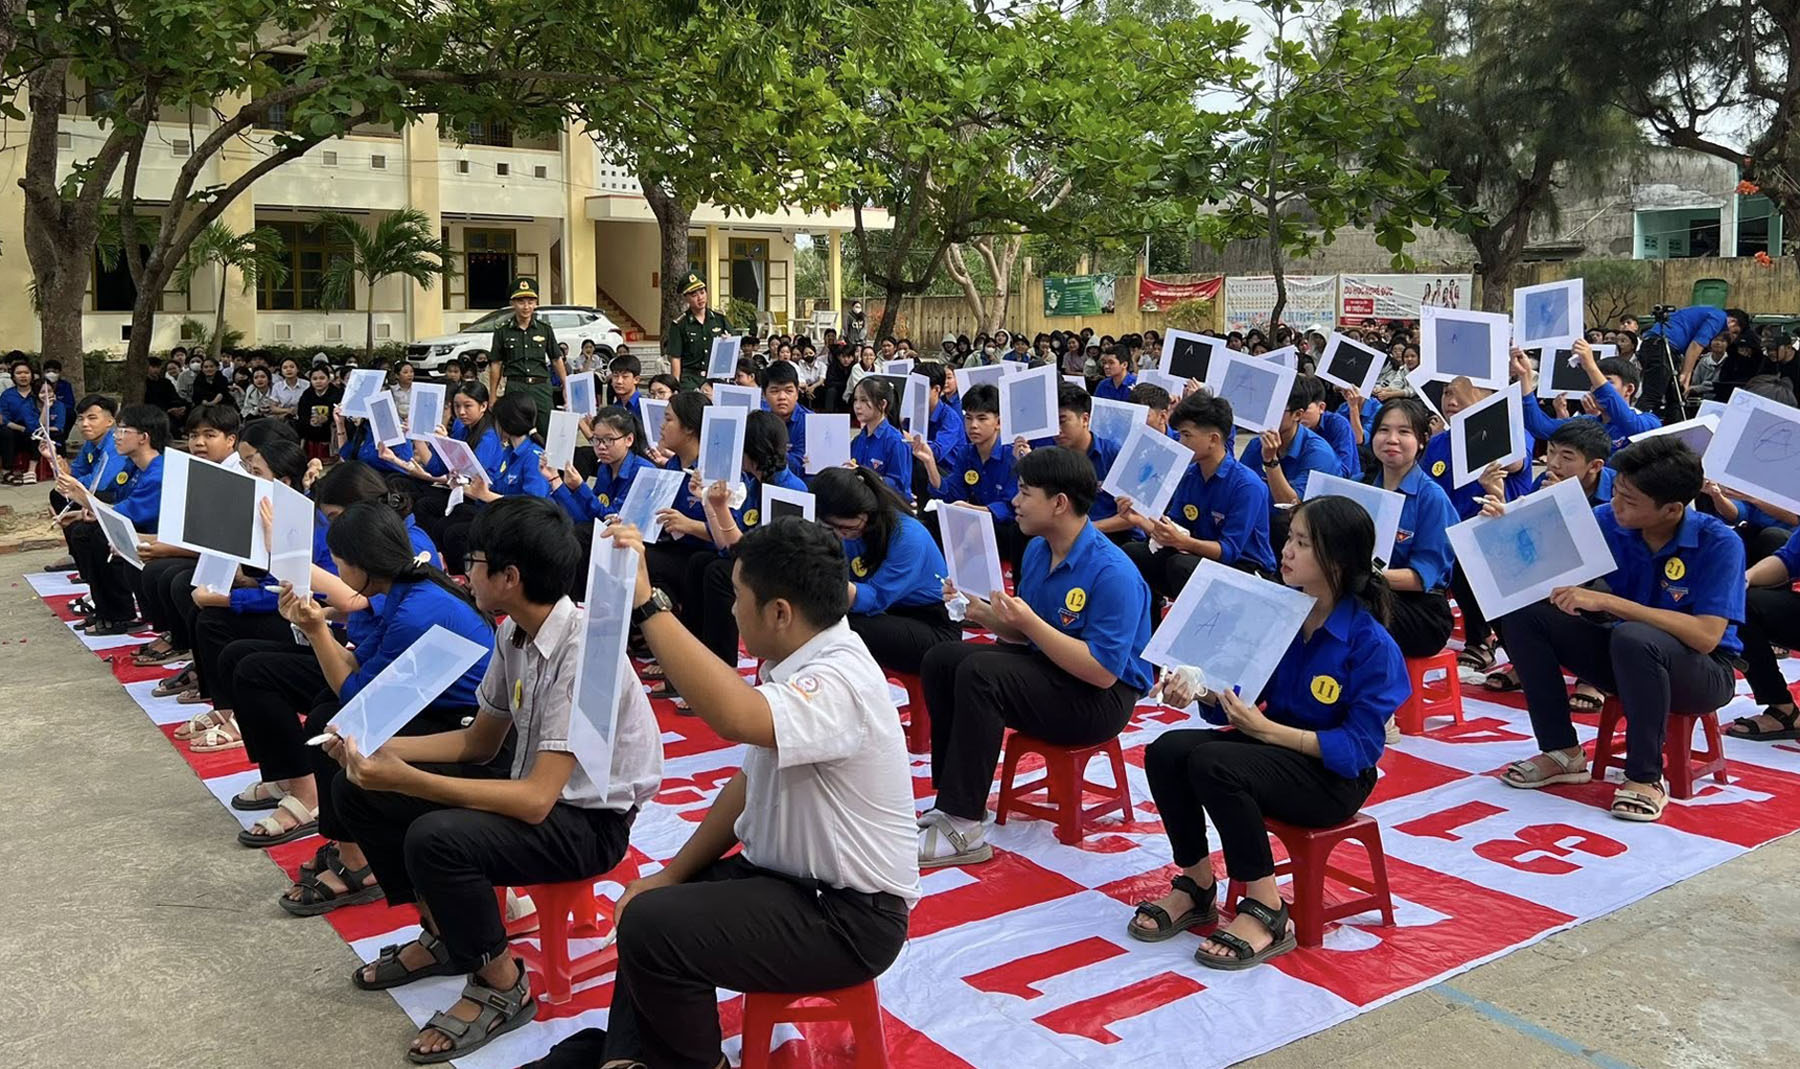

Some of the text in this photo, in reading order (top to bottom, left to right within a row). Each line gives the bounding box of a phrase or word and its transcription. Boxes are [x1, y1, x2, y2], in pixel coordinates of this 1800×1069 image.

[1184, 344, 1194, 356] A
[1667, 561, 1682, 577] 21
[1070, 592, 1084, 607] 12
[1194, 612, 1220, 637] A
[1317, 680, 1335, 698] 11
[960, 935, 1209, 1045] 11
